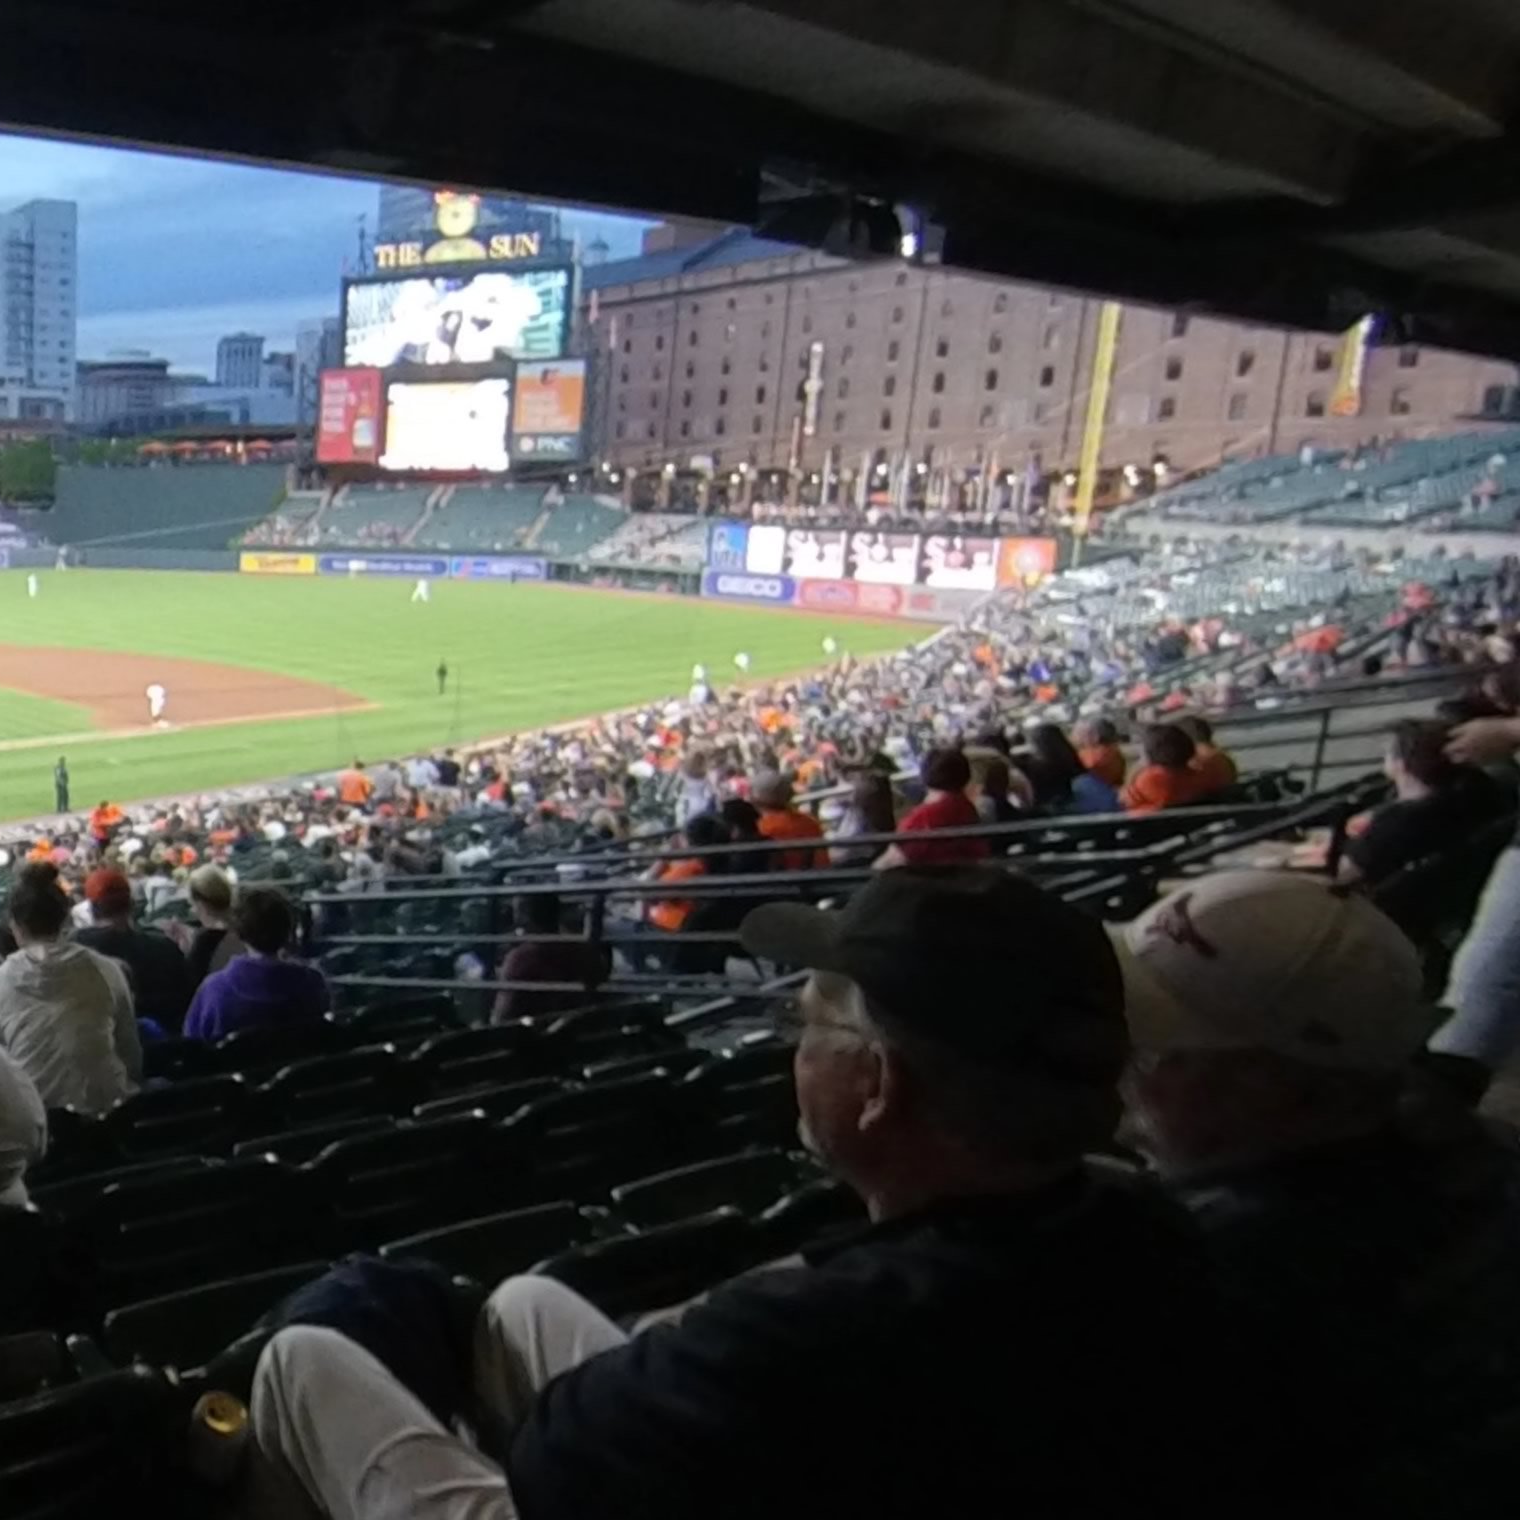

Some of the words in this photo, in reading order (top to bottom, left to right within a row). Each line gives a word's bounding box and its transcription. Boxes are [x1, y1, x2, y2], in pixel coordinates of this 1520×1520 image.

[375, 242, 423, 267] THE
[490, 232, 540, 259] SUN
[716, 575, 782, 598] GEICO
